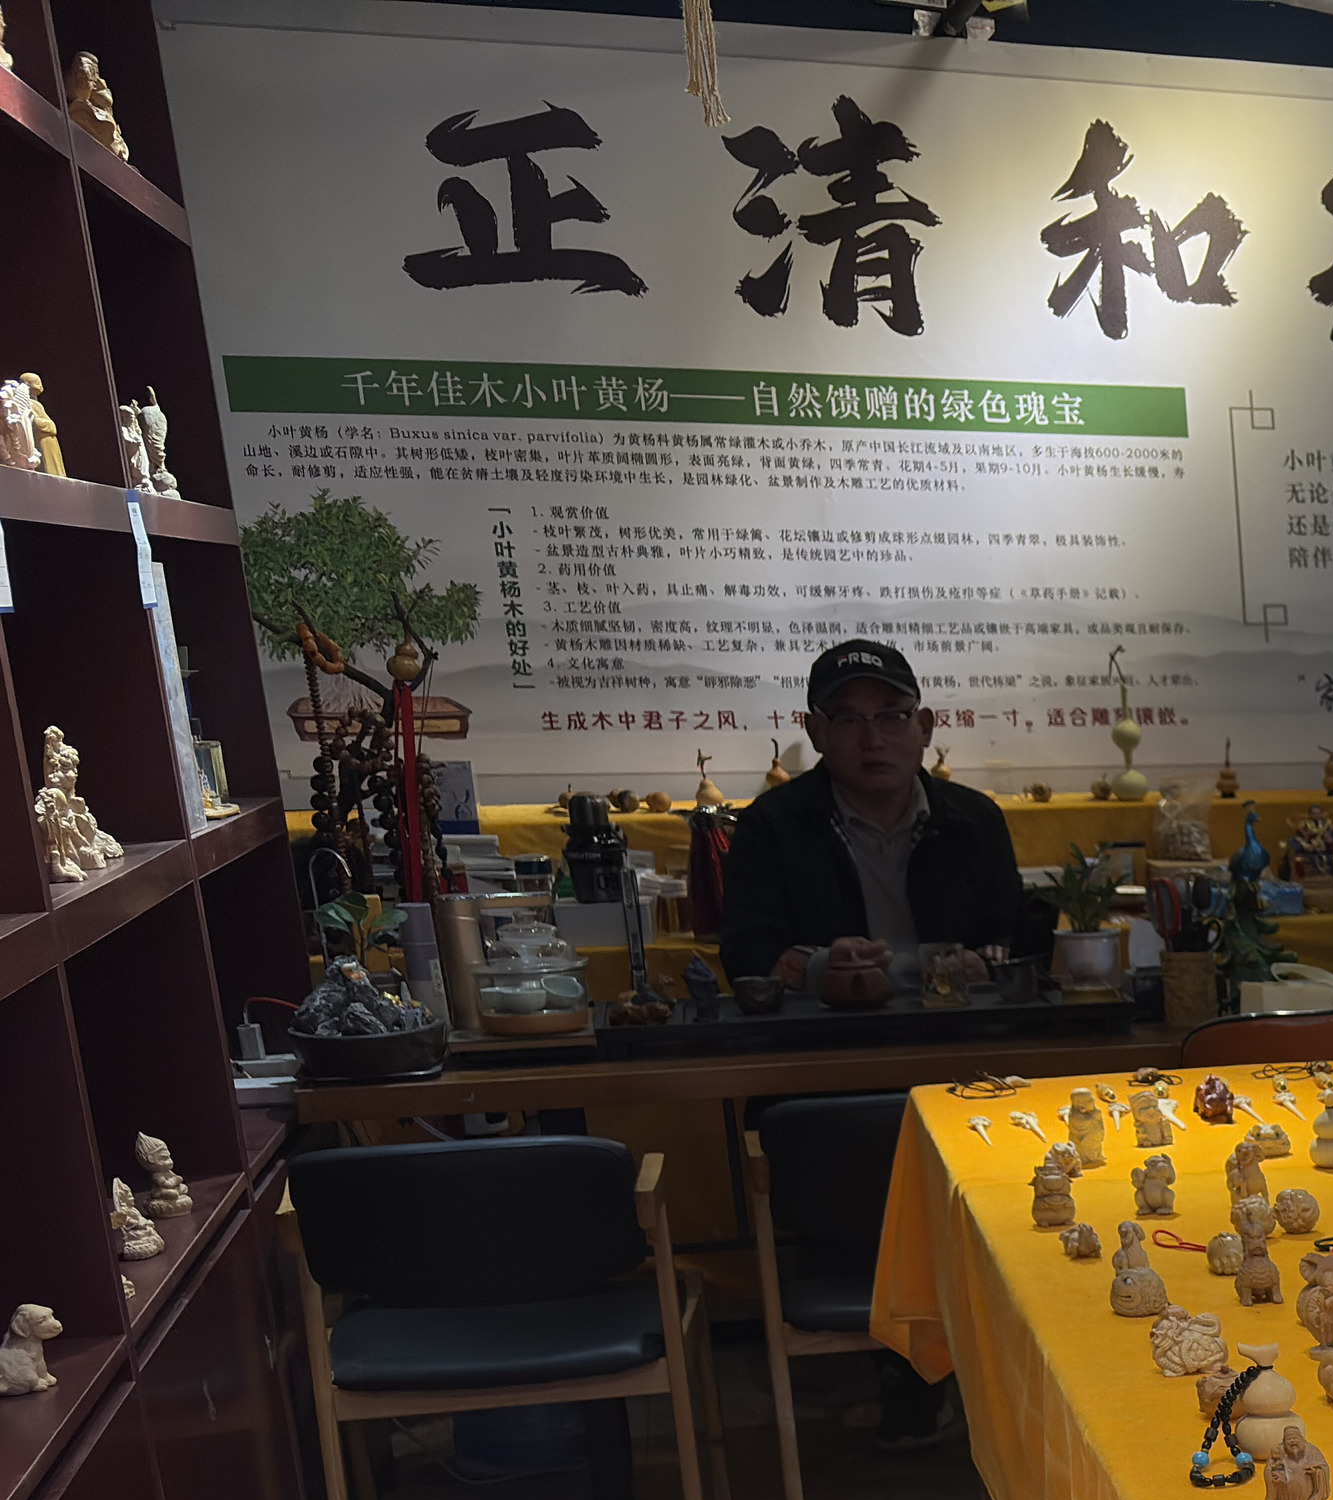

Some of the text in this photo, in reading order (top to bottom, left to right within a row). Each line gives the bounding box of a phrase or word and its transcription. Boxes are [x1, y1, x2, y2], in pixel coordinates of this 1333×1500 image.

[341, 369, 1087, 427] 千年佳木小叶黄杨——自然馈赠的绿色瑰宝
[443, 428, 489, 442] sinica
[493, 431, 524, 443] var.
